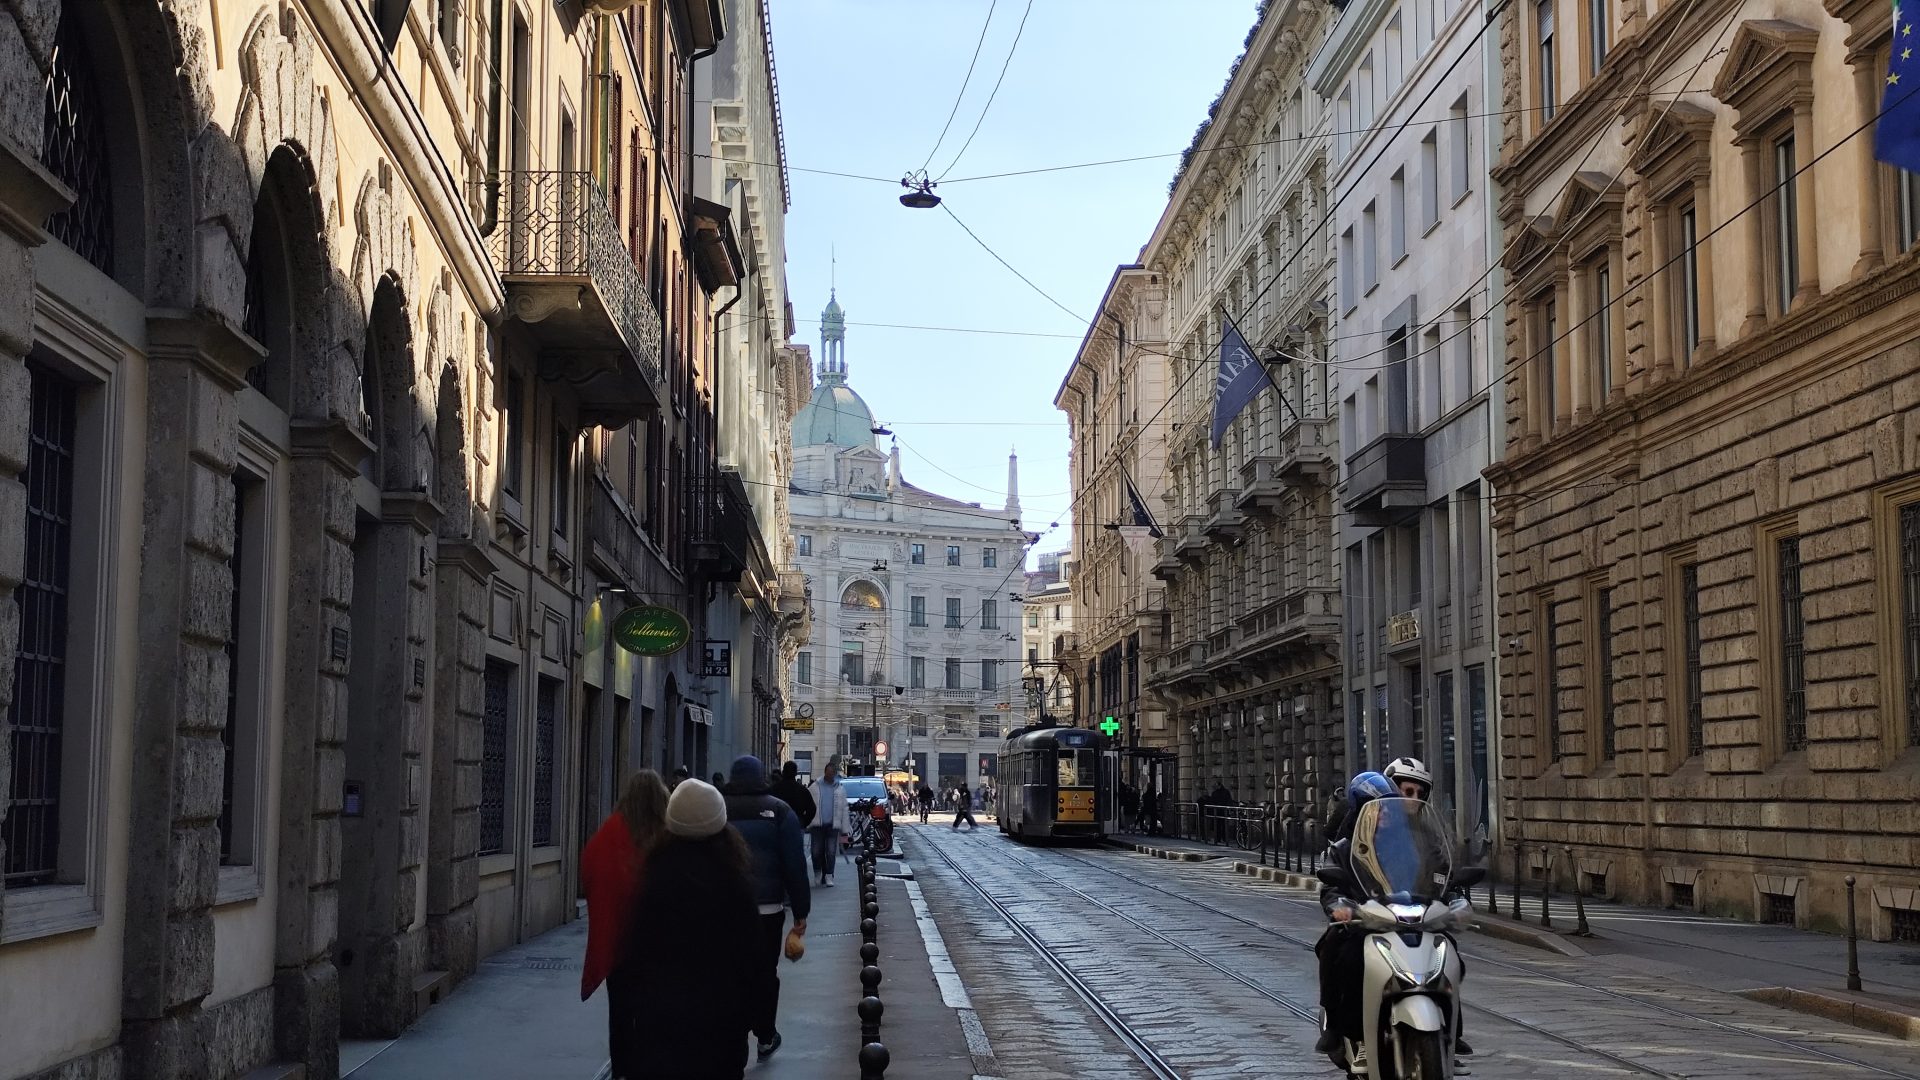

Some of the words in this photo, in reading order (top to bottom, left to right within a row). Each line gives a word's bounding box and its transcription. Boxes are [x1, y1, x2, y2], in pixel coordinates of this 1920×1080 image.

[623, 621, 681, 638] Bellavista
[706, 643, 728, 660] T
[715, 666, 728, 674] 24
